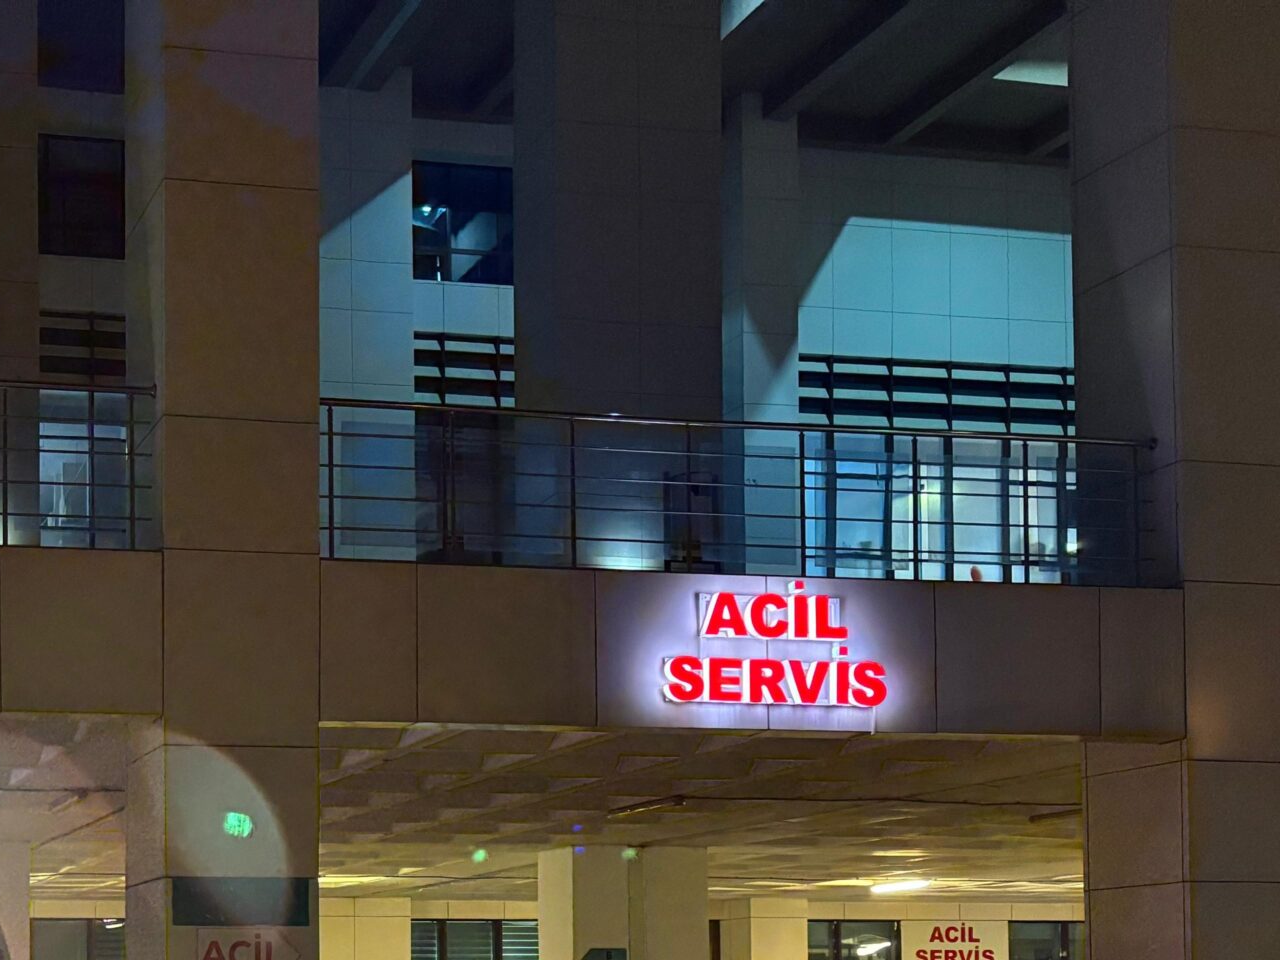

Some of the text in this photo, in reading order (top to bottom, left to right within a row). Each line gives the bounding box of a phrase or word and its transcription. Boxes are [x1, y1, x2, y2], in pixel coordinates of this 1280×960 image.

[702, 579, 848, 640] ACİL
[666, 646, 888, 707] SERVİS
[929, 922, 981, 943] ACİL
